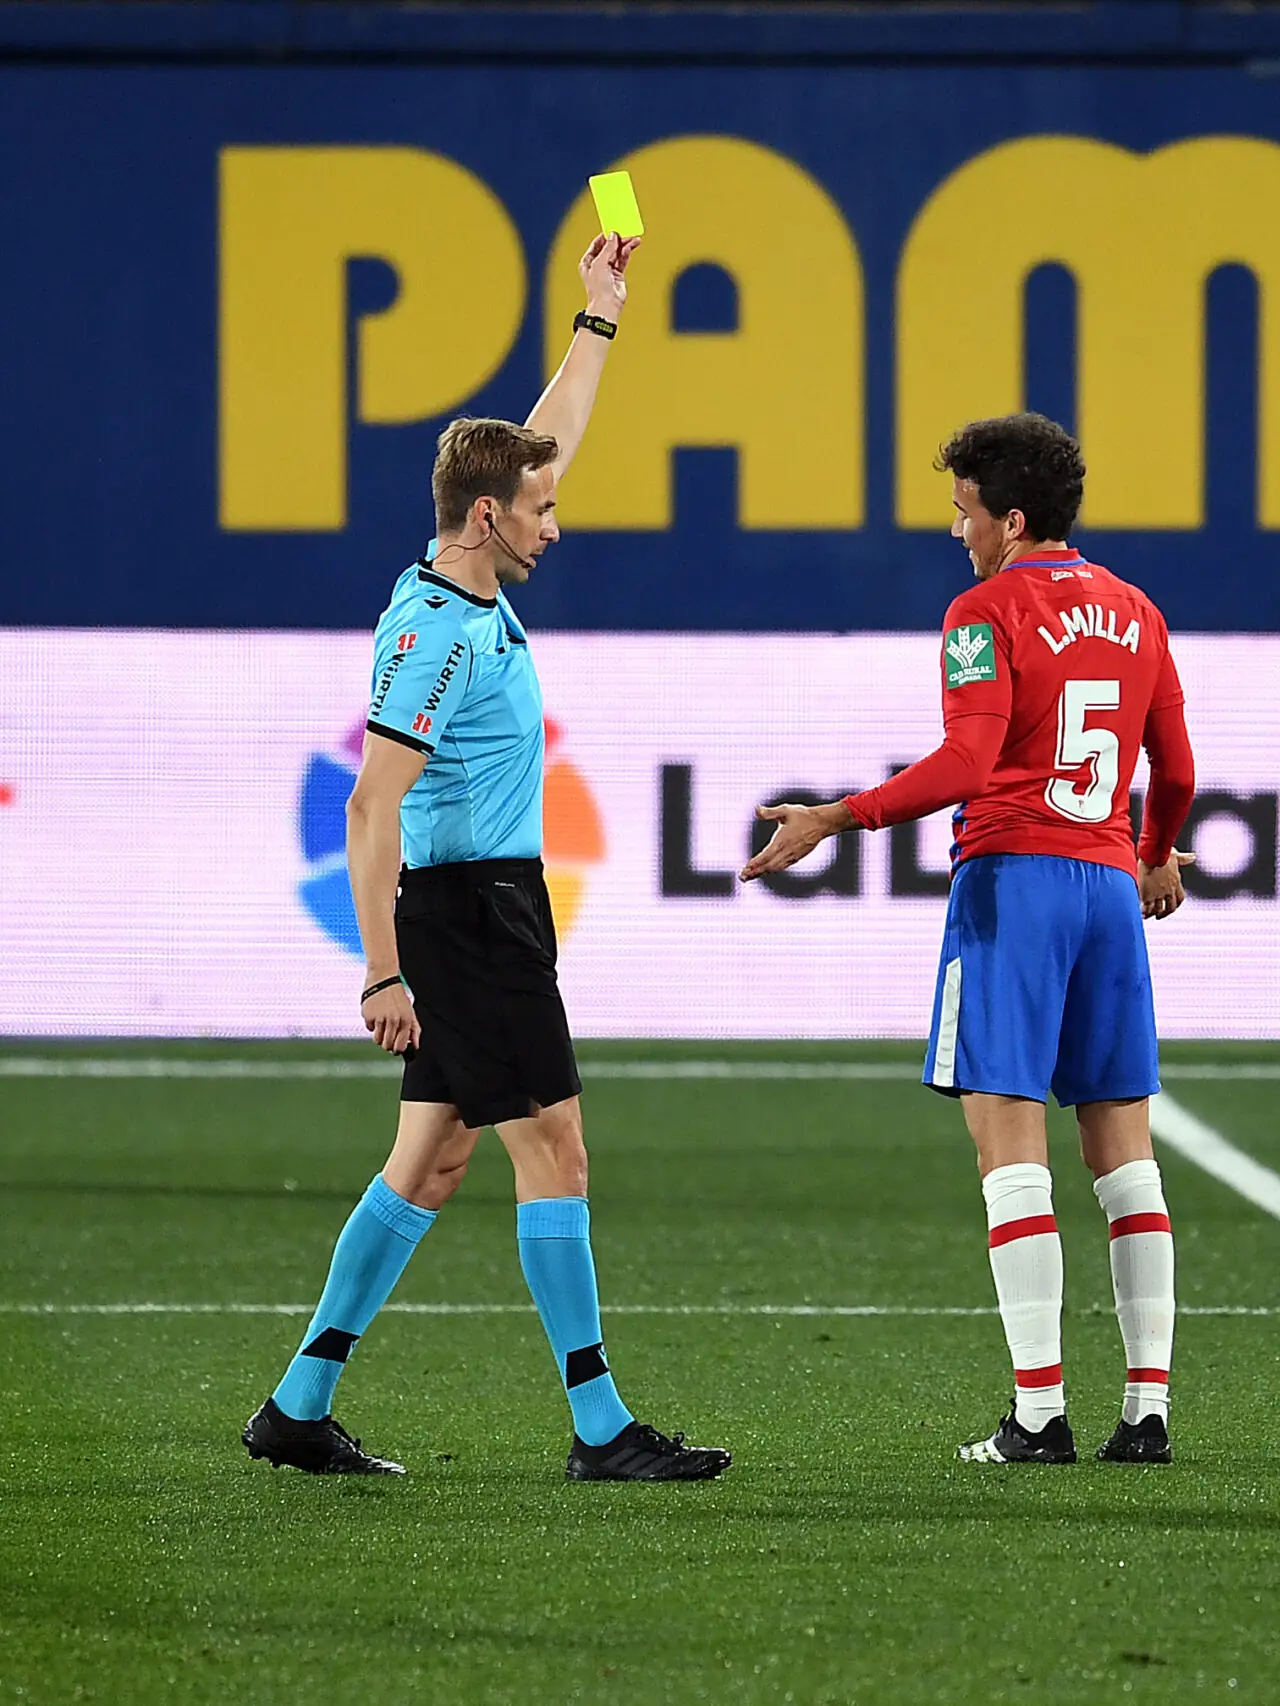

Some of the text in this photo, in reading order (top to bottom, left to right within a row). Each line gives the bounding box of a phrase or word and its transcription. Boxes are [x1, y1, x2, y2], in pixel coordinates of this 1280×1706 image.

[423, 641, 466, 712] WÜRTH
[1037, 603, 1140, 655] L.MILLA
[1044, 680, 1120, 823] 5
[659, 762, 1280, 899] LaLa
